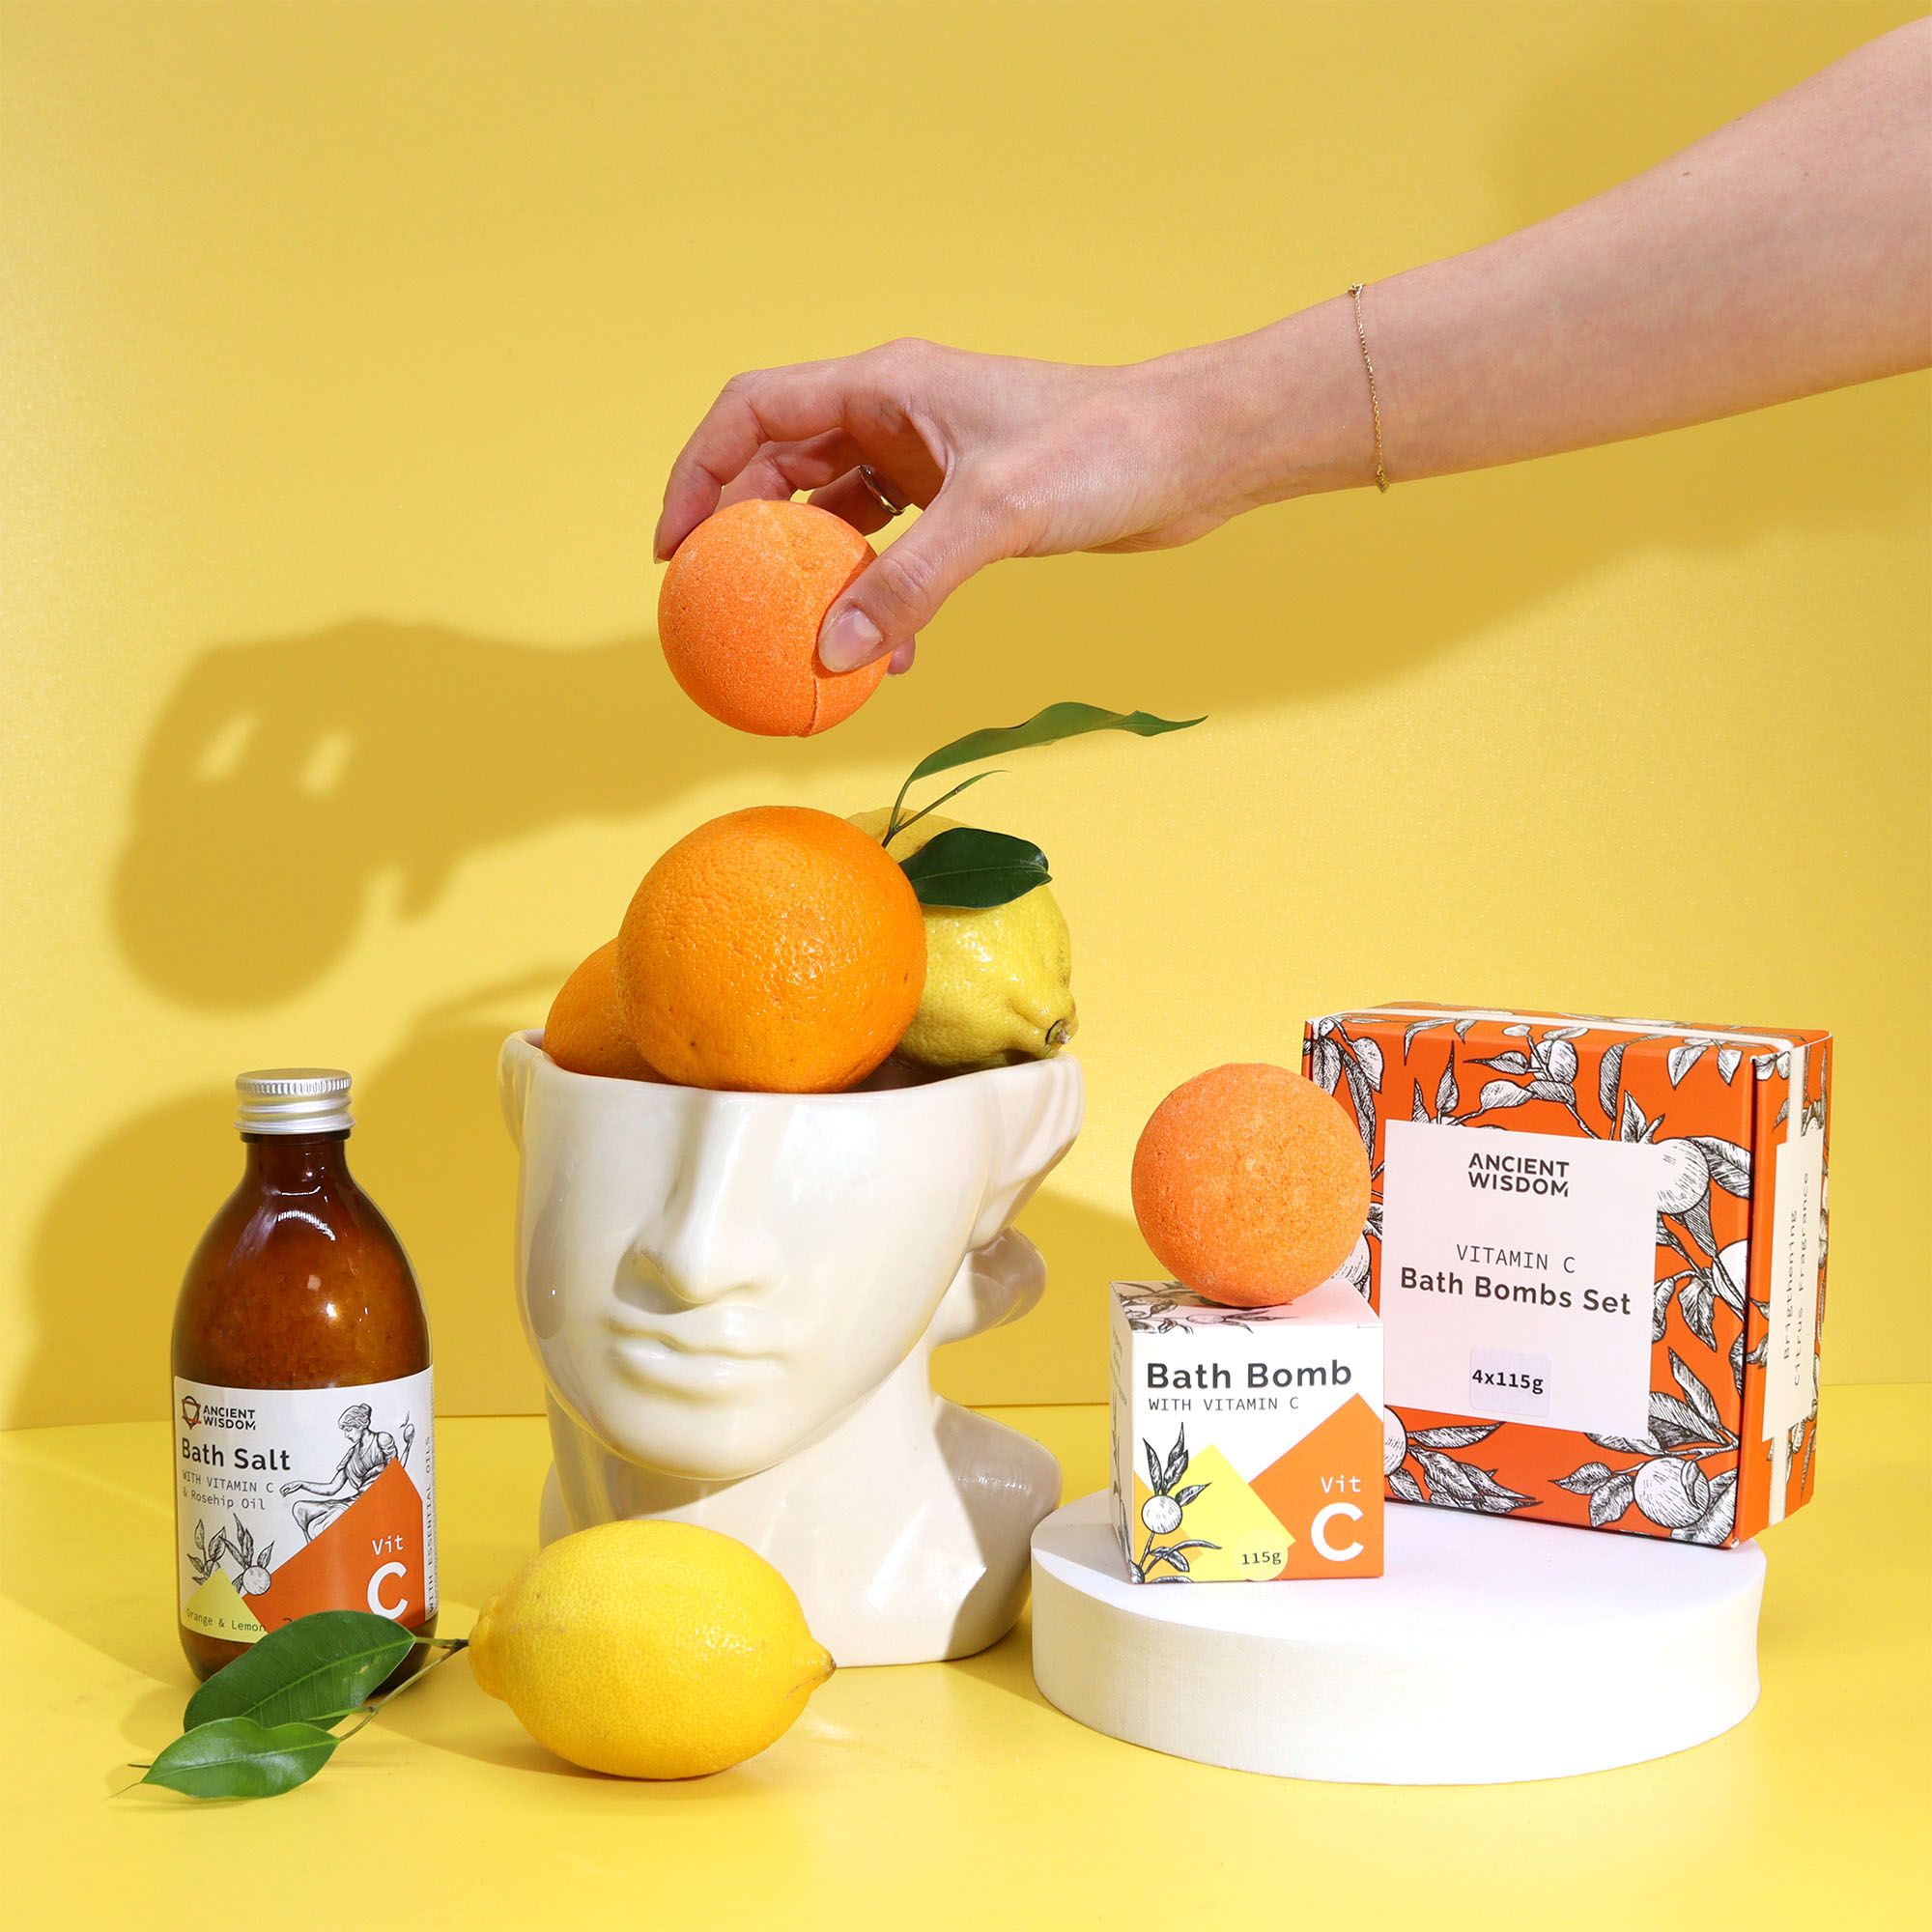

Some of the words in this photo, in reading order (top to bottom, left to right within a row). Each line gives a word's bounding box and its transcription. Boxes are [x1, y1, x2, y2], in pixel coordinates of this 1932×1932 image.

[1468, 1152, 1570, 1178] ANCIENT
[1468, 1172, 1569, 1197] WISDOM
[1798, 1172, 1808, 1293] Fragrance
[1456, 1243, 1548, 1270] VITAMIN
[1563, 1257, 1576, 1273] C
[1401, 1266, 1463, 1295] Bath
[1475, 1275, 1572, 1308] Bombs
[1582, 1289, 1631, 1315] Set
[1783, 1209, 1798, 1360] Brigthening
[1794, 1307, 1804, 1387] Citrus
[1147, 1362, 1232, 1389] Bath
[1247, 1359, 1352, 1388] Bomb
[1471, 1369, 1544, 1394] 4x115g
[203, 1405, 256, 1420] ANCIENT
[1149, 1398, 1191, 1411] WITH
[1204, 1398, 1278, 1411] VITAMIN
[1290, 1397, 1299, 1409] C
[203, 1415, 256, 1431] WISDOM
[182, 1436, 224, 1467] Bath
[234, 1448, 291, 1470] Salt
[183, 1469, 200, 1485] WITH
[207, 1476, 257, 1492] VITAMIN
[266, 1483, 274, 1493] C
[1321, 1474, 1361, 1493] Vit
[183, 1488, 188, 1498] &
[190, 1490, 235, 1509] Rosehip
[242, 1498, 266, 1510] Oil
[1311, 1501, 1364, 1562] C
[372, 1535, 404, 1555] Vit
[1241, 1550, 1282, 1566] 115g
[367, 1561, 408, 1620] C
[185, 1607, 213, 1627] Orange
[218, 1617, 225, 1628] &
[232, 1620, 267, 1633] Lemon
